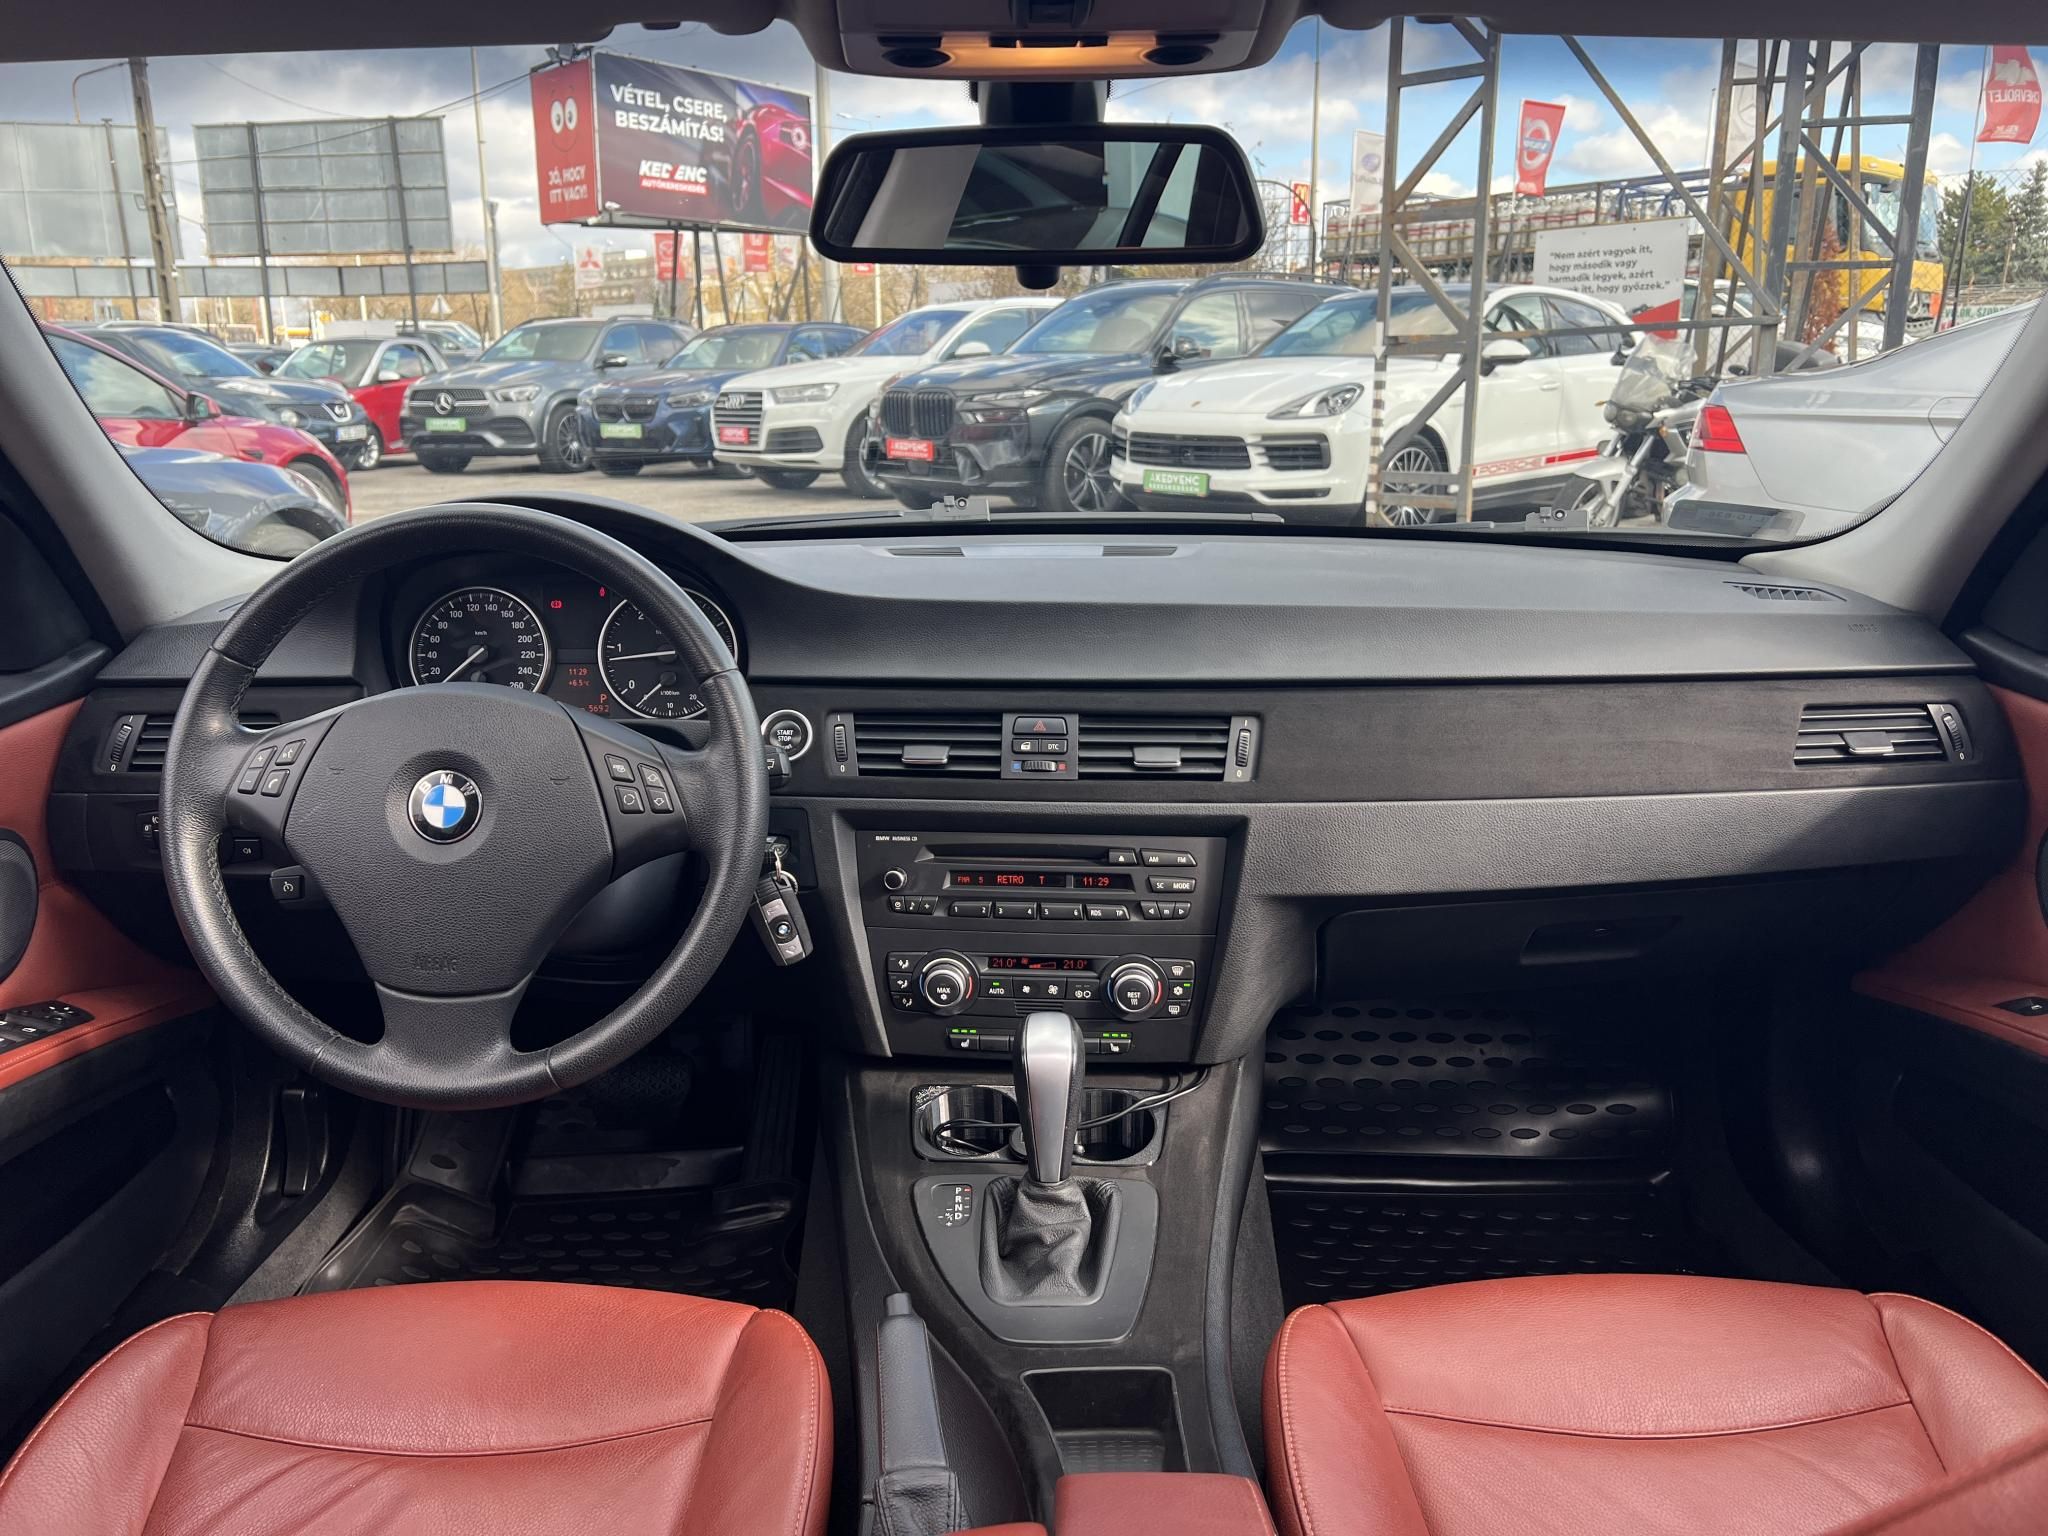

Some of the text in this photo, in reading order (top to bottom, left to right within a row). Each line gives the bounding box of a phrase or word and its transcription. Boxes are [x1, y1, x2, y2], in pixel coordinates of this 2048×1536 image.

[610, 83, 728, 123] VÉTEL, CSERE,
[615, 110, 724, 142] BESZÁMÍTÁS!
[1577, 248, 1600, 258] azért
[1602, 246, 1636, 258] vagyok
[1638, 244, 1653, 254] itt,
[1548, 258, 1638, 273] hogy második vagy
[1548, 270, 1654, 283] harmadik legyek, azért
[1597, 284, 1620, 294] hogy
[616, 643, 622, 653] 1
[628, 680, 635, 689] 0
[600, 694, 607, 703] P
[419, 774, 476, 796] BMW
[997, 875, 1024, 885] RETRO
[1039, 875, 1045, 885] T
[1083, 876, 1110, 886] 11:29
